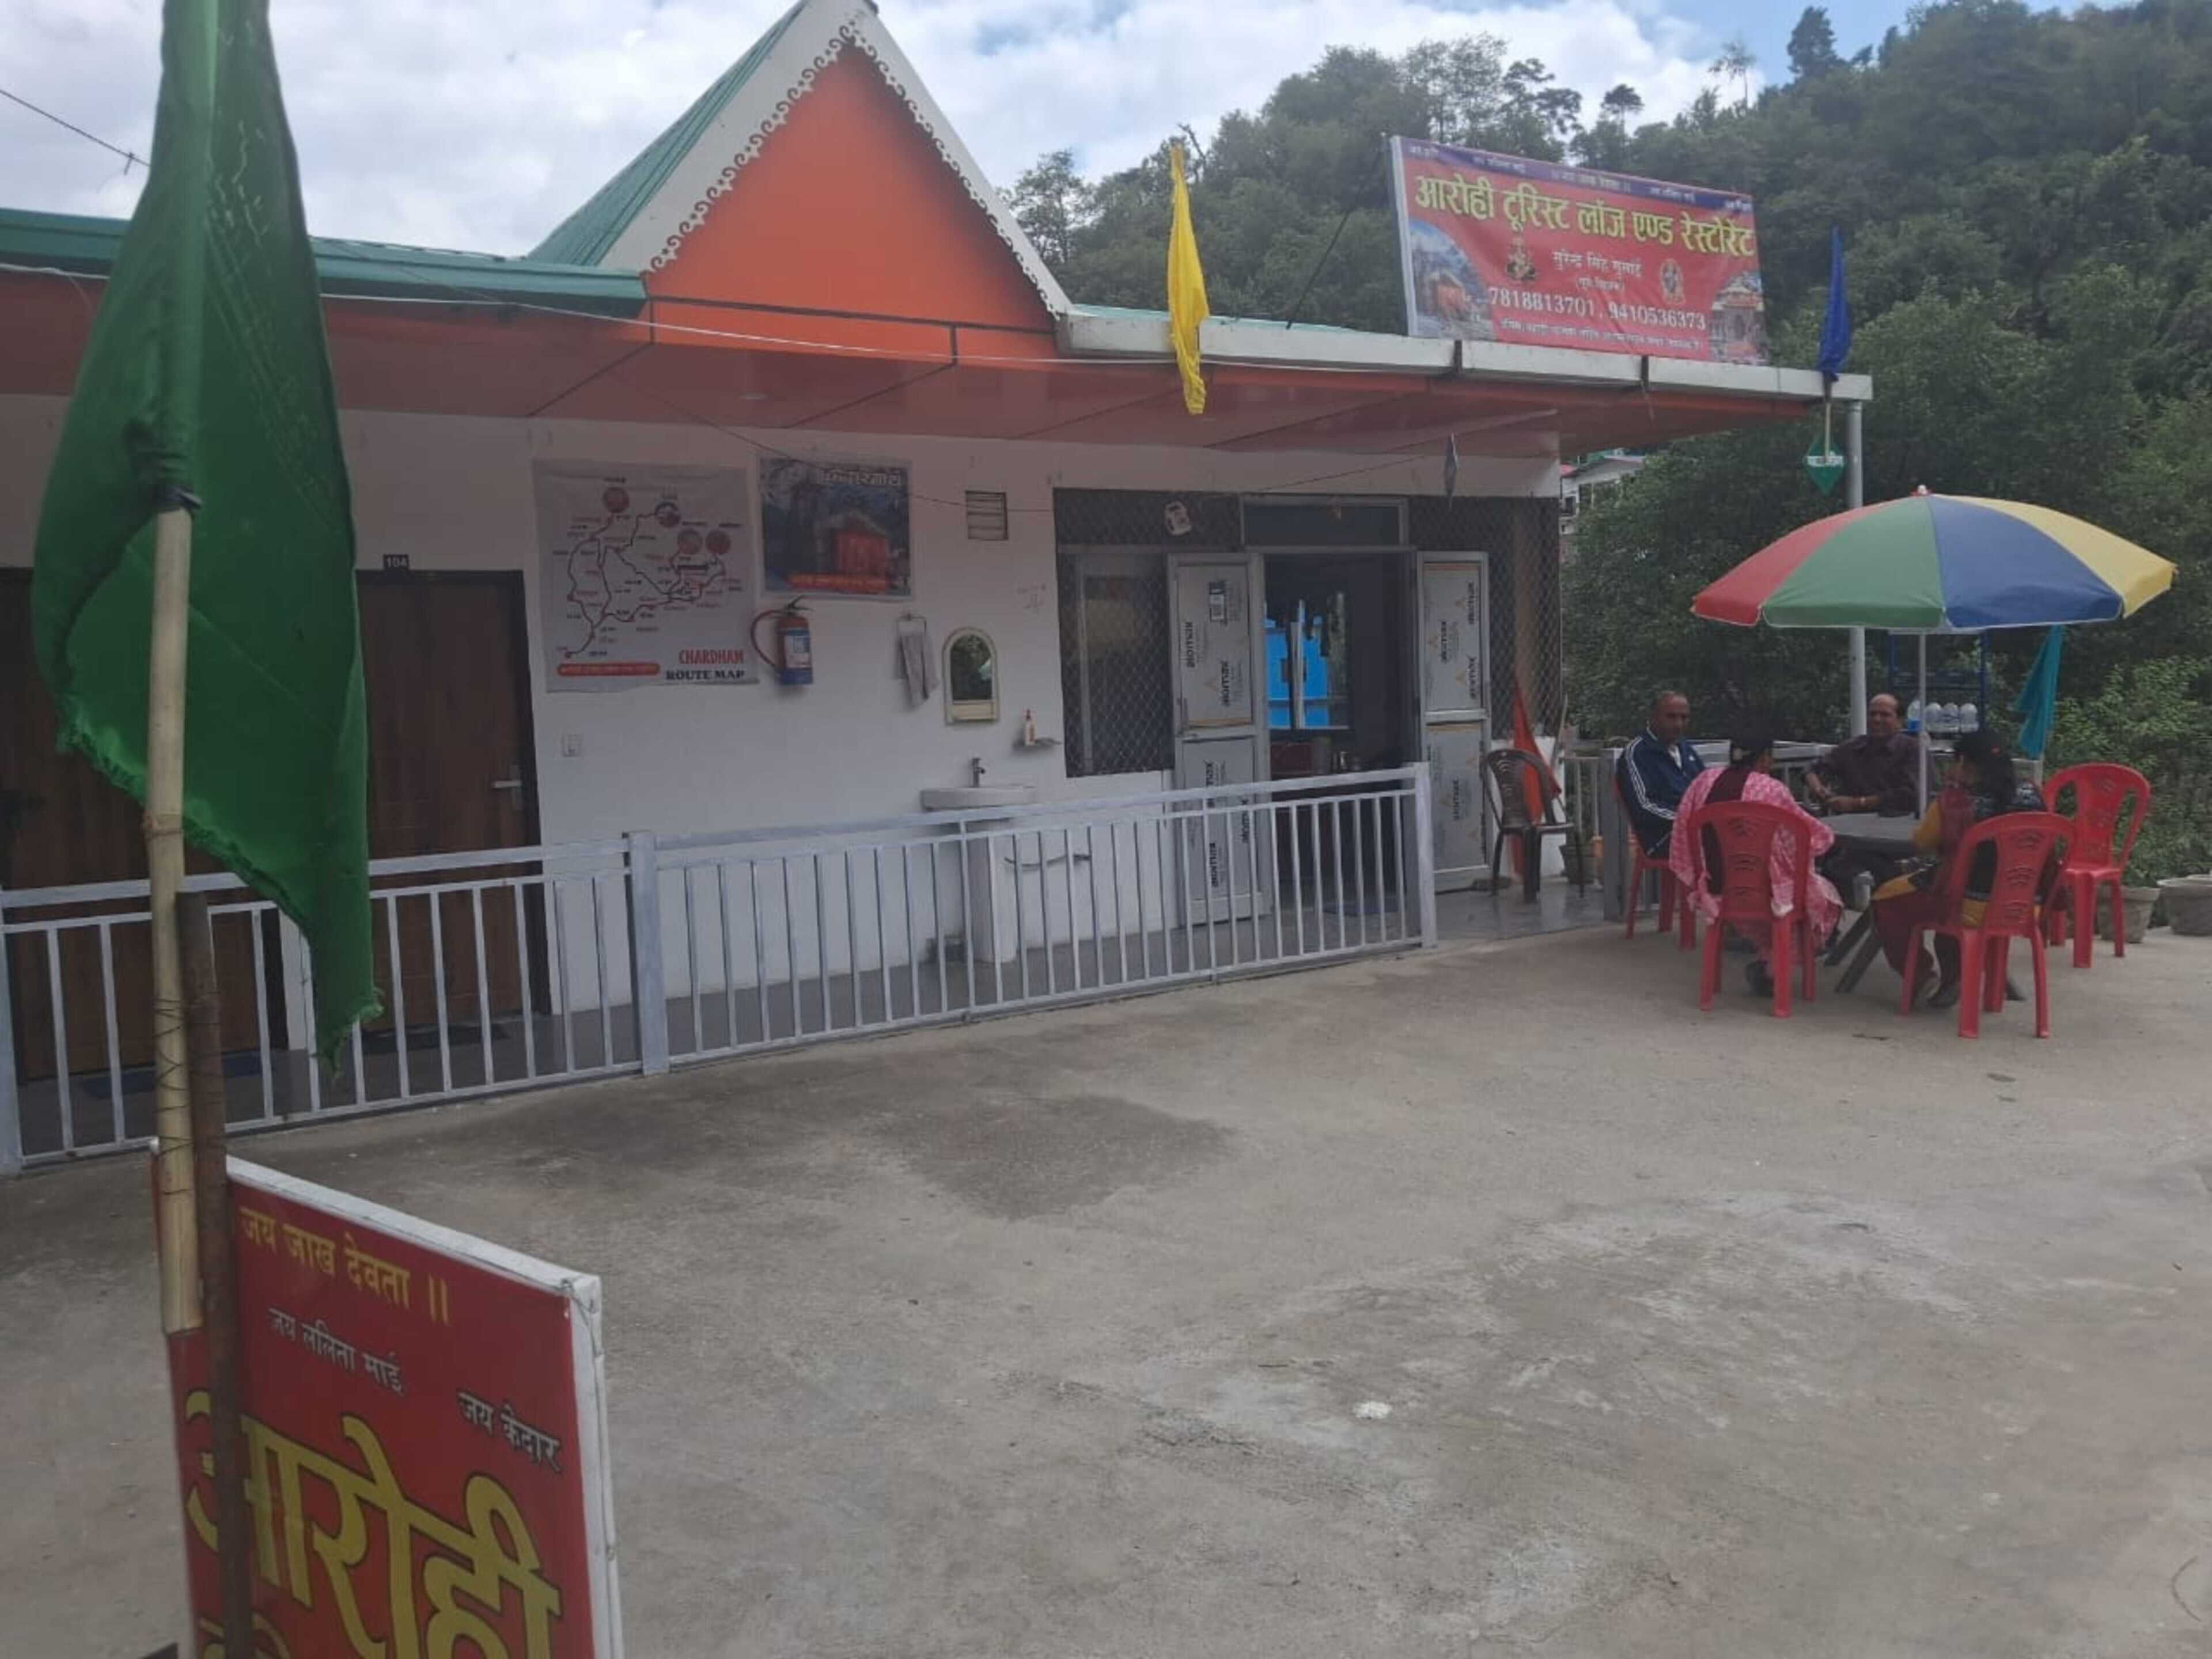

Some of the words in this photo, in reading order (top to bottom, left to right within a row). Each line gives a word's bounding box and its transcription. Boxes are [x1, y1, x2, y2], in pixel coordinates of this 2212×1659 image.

[1415, 172, 1494, 219] आरोही
[666, 670, 711, 681] ROUTE
[715, 669, 745, 679] MAP
[679, 649, 744, 664] CHARDHAM
[240, 1206, 277, 1255] जय
[344, 1230, 411, 1310] देवता
[268, 1307, 296, 1340] जय
[301, 1319, 356, 1371] ललिता
[457, 1391, 494, 1438] जय
[500, 1403, 562, 1473] केदार
